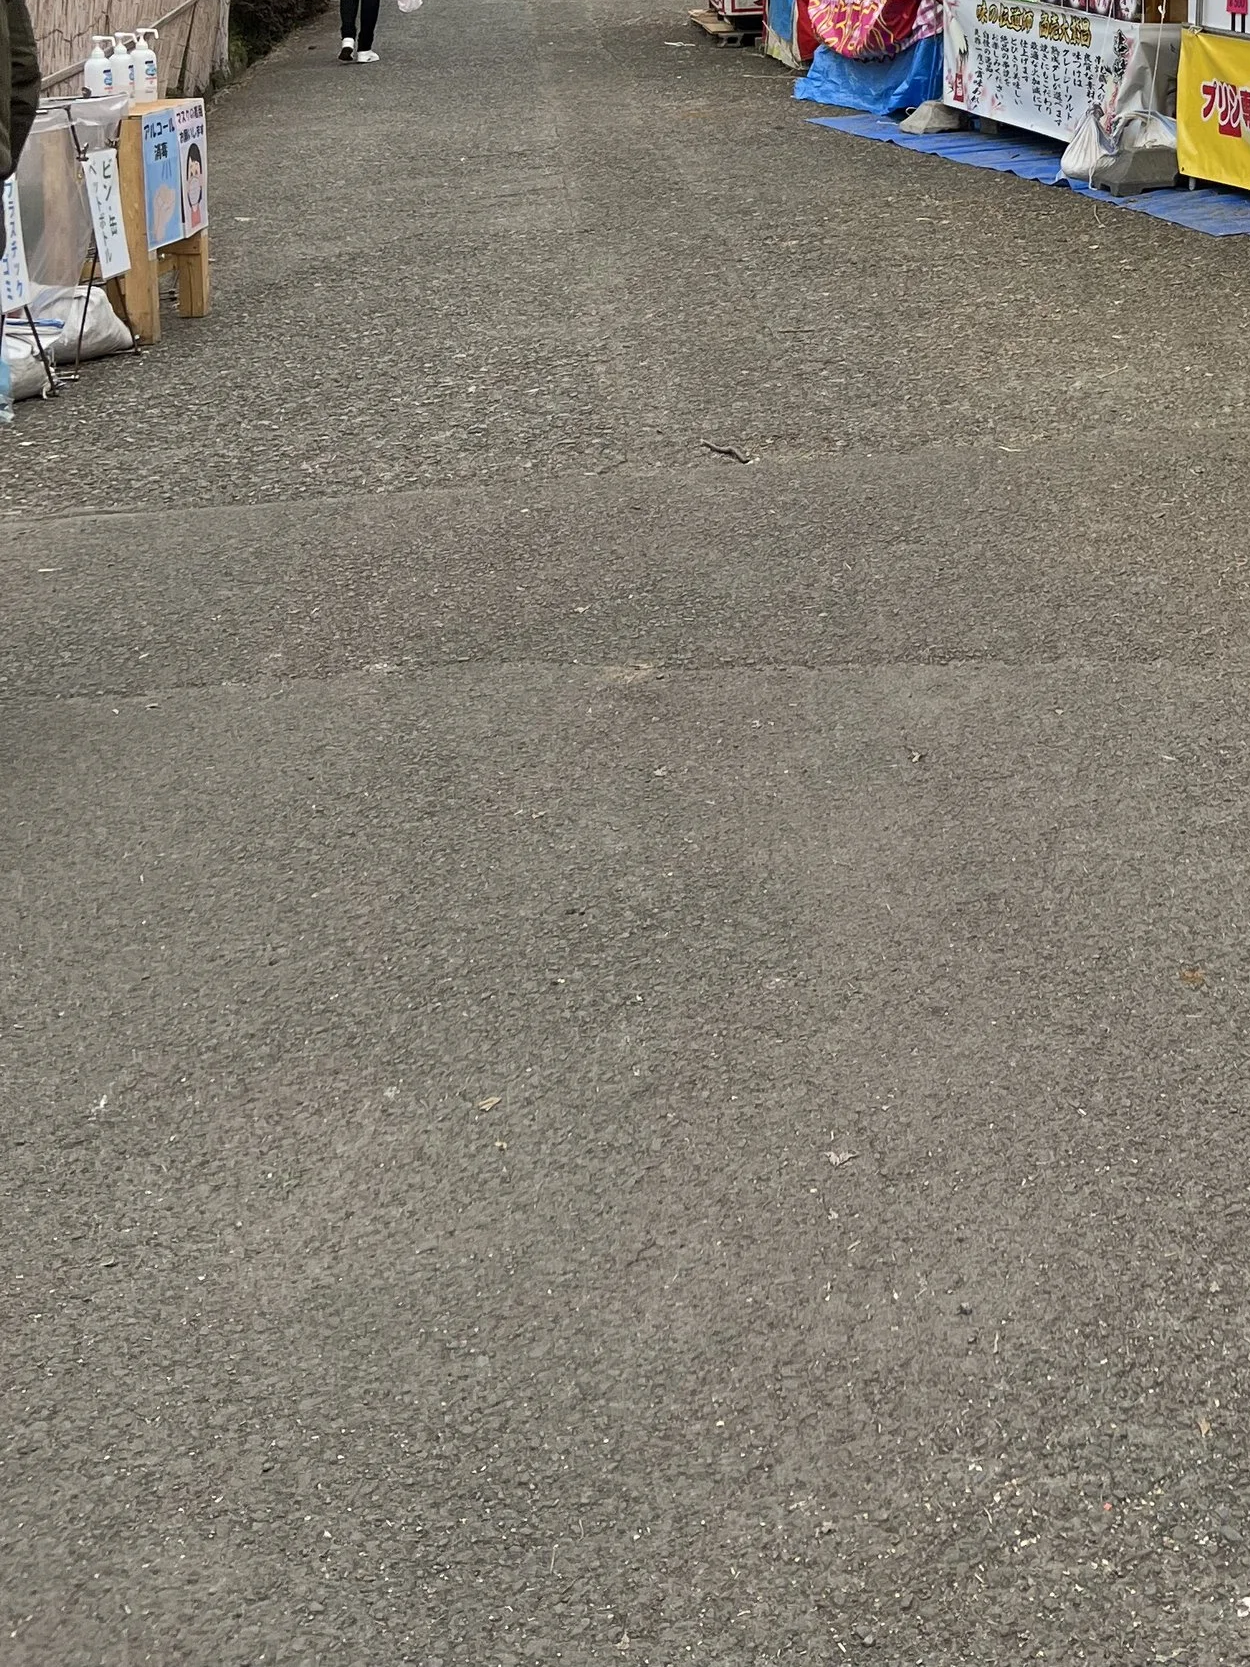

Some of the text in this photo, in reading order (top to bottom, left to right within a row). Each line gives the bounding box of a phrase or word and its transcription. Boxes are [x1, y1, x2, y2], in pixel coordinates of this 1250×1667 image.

[144, 118, 175, 140] アルコール
[154, 142, 168, 160] 消毒
